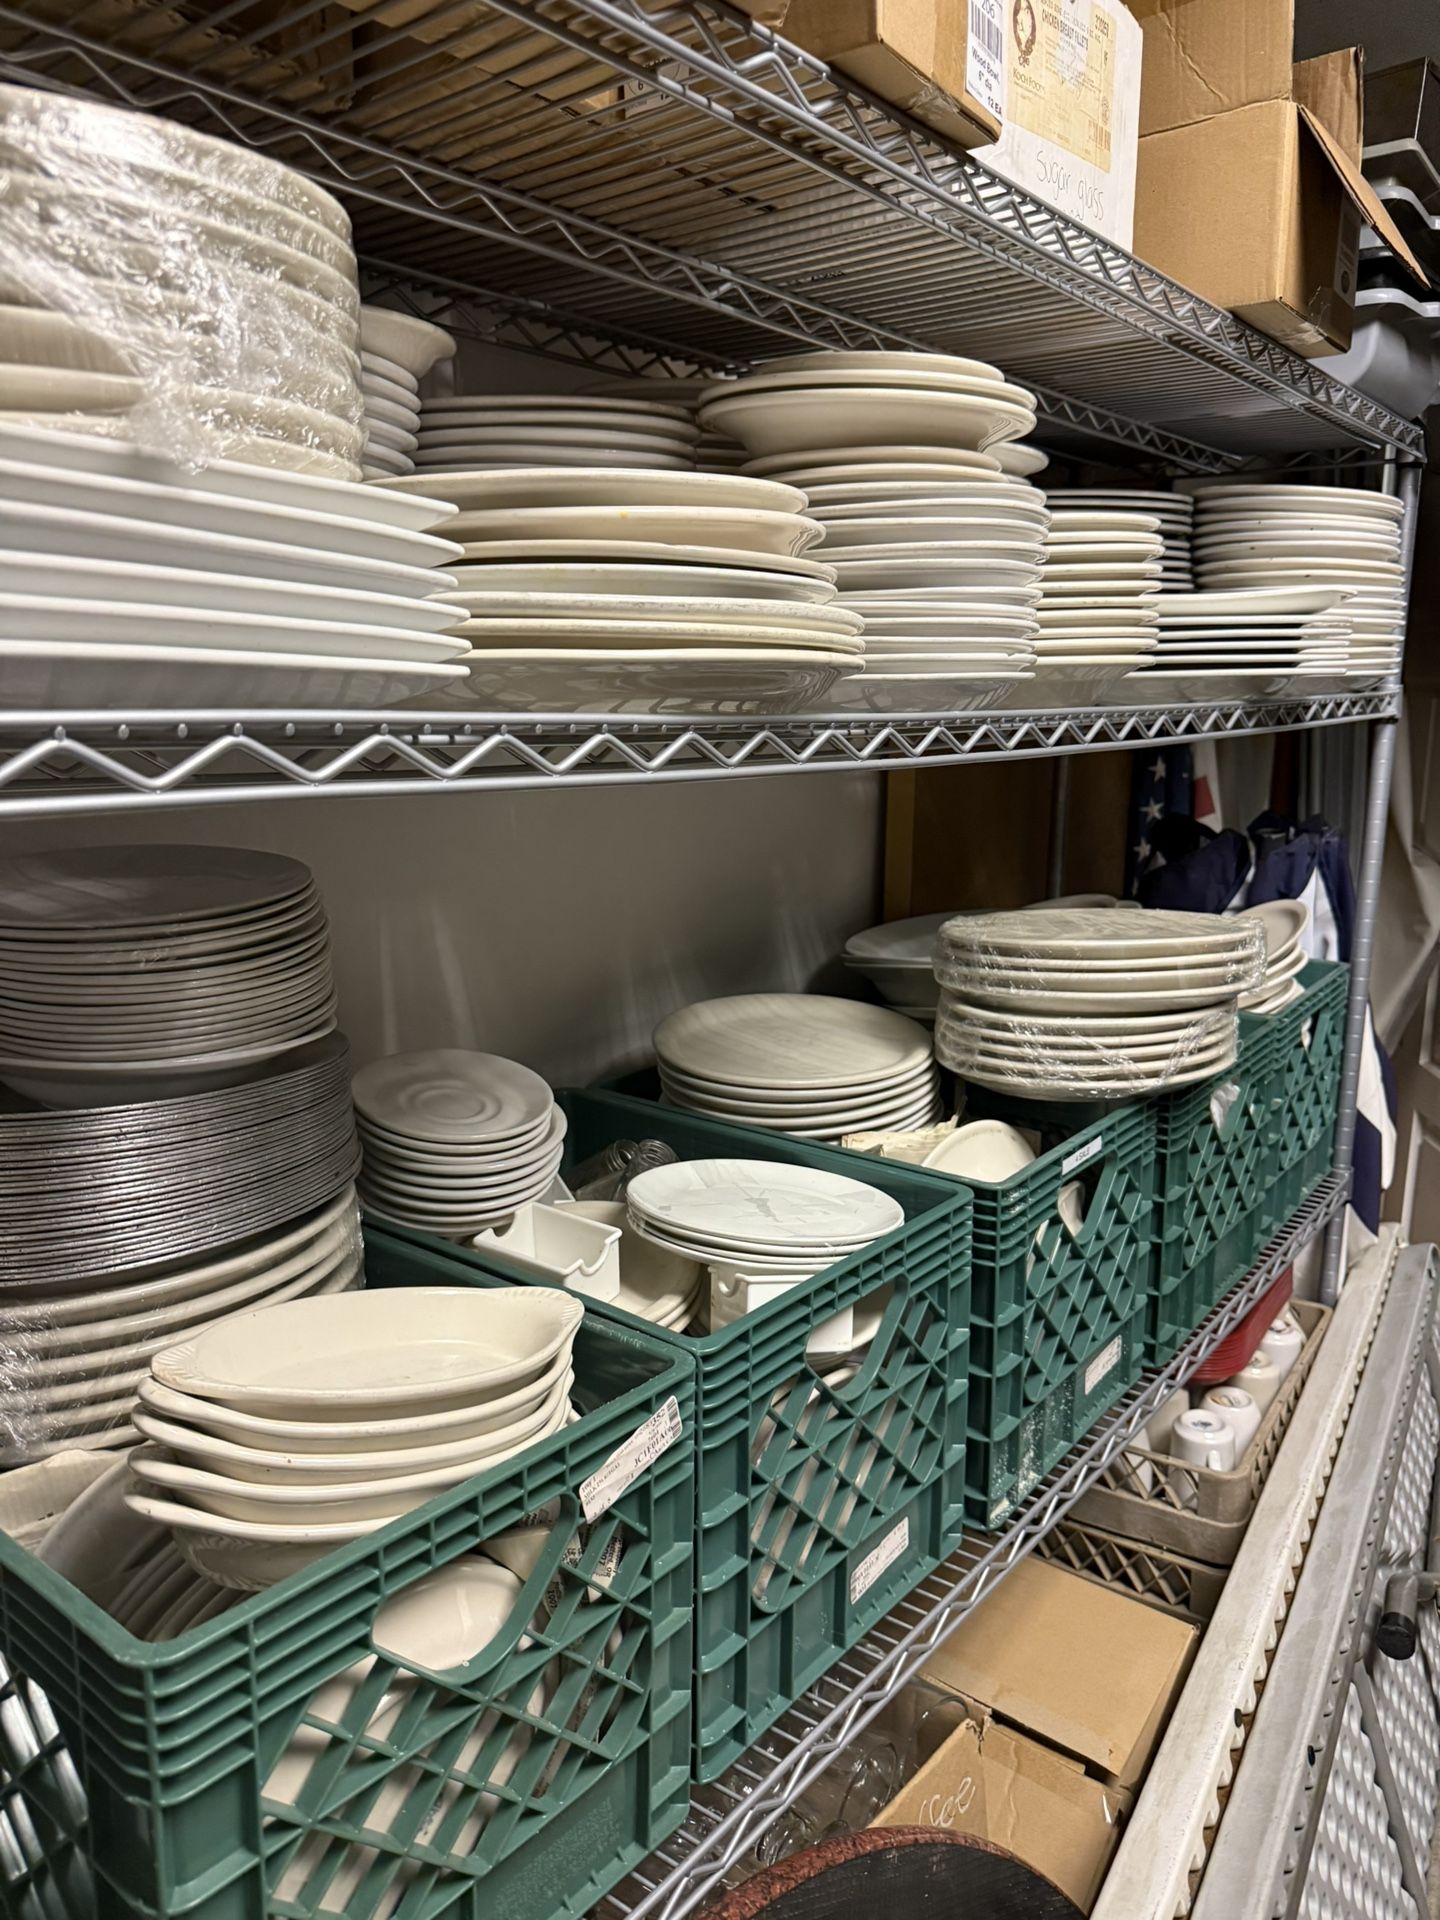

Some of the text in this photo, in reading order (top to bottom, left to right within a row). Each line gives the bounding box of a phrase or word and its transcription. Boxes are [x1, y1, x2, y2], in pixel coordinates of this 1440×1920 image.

[1041, 8, 1060, 31] CHICKEN
[1060, 20, 1075, 41] BREAST
[972, 46, 986, 70] Wood
[1013, 67, 1029, 84] KOCH
[1036, 150, 1104, 221] Sugar glass
